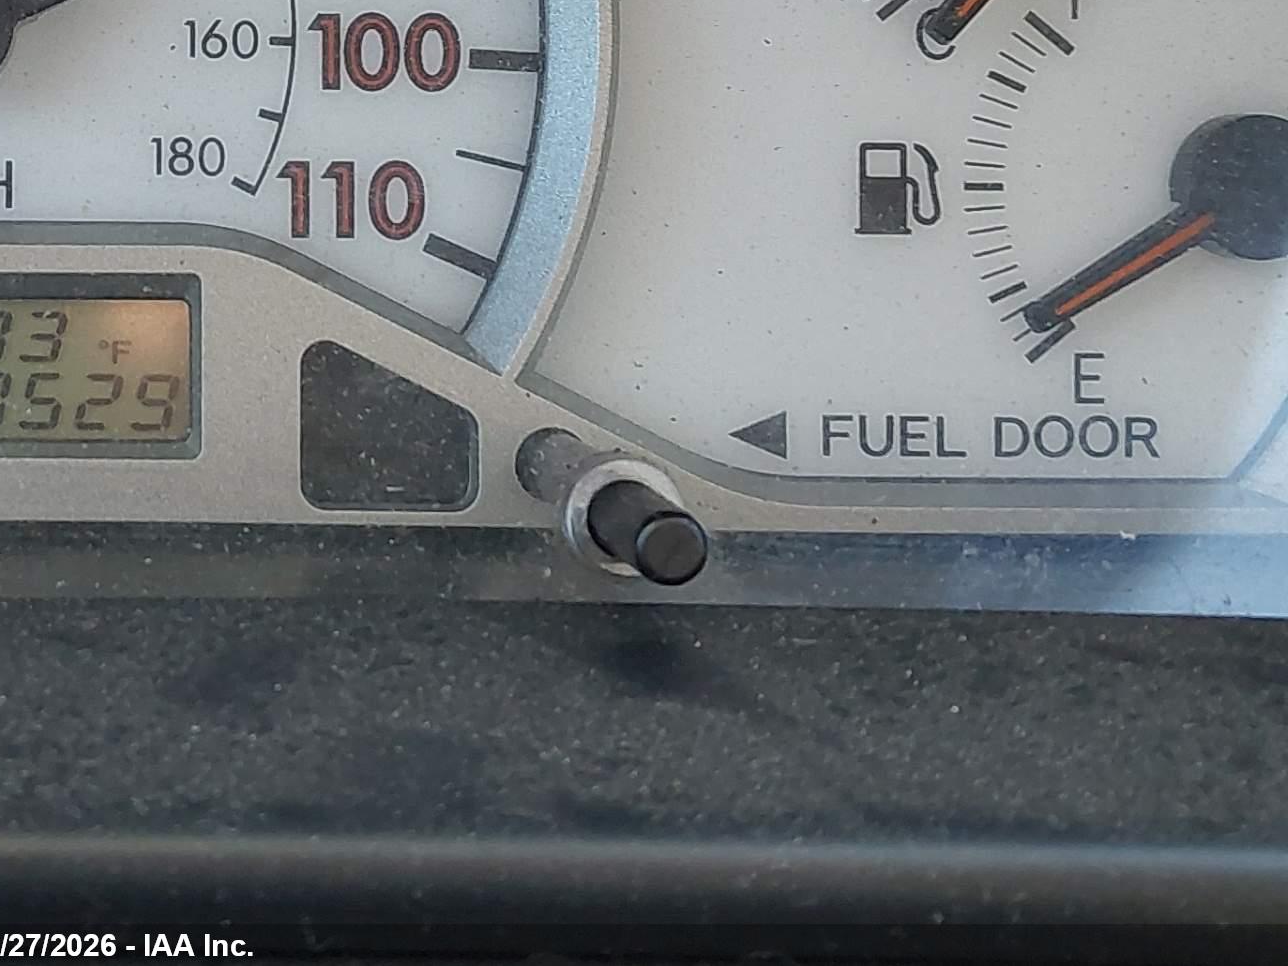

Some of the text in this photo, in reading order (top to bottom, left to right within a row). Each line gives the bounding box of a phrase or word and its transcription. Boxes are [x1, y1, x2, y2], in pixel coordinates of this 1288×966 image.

[184, 20, 258, 58] 160
[309, 13, 461, 92] 100
[151, 138, 224, 177] 180
[276, 161, 424, 240] 110
[1074, 353, 1105, 404] E
[822, 415, 1159, 458] FUEL DOOR
